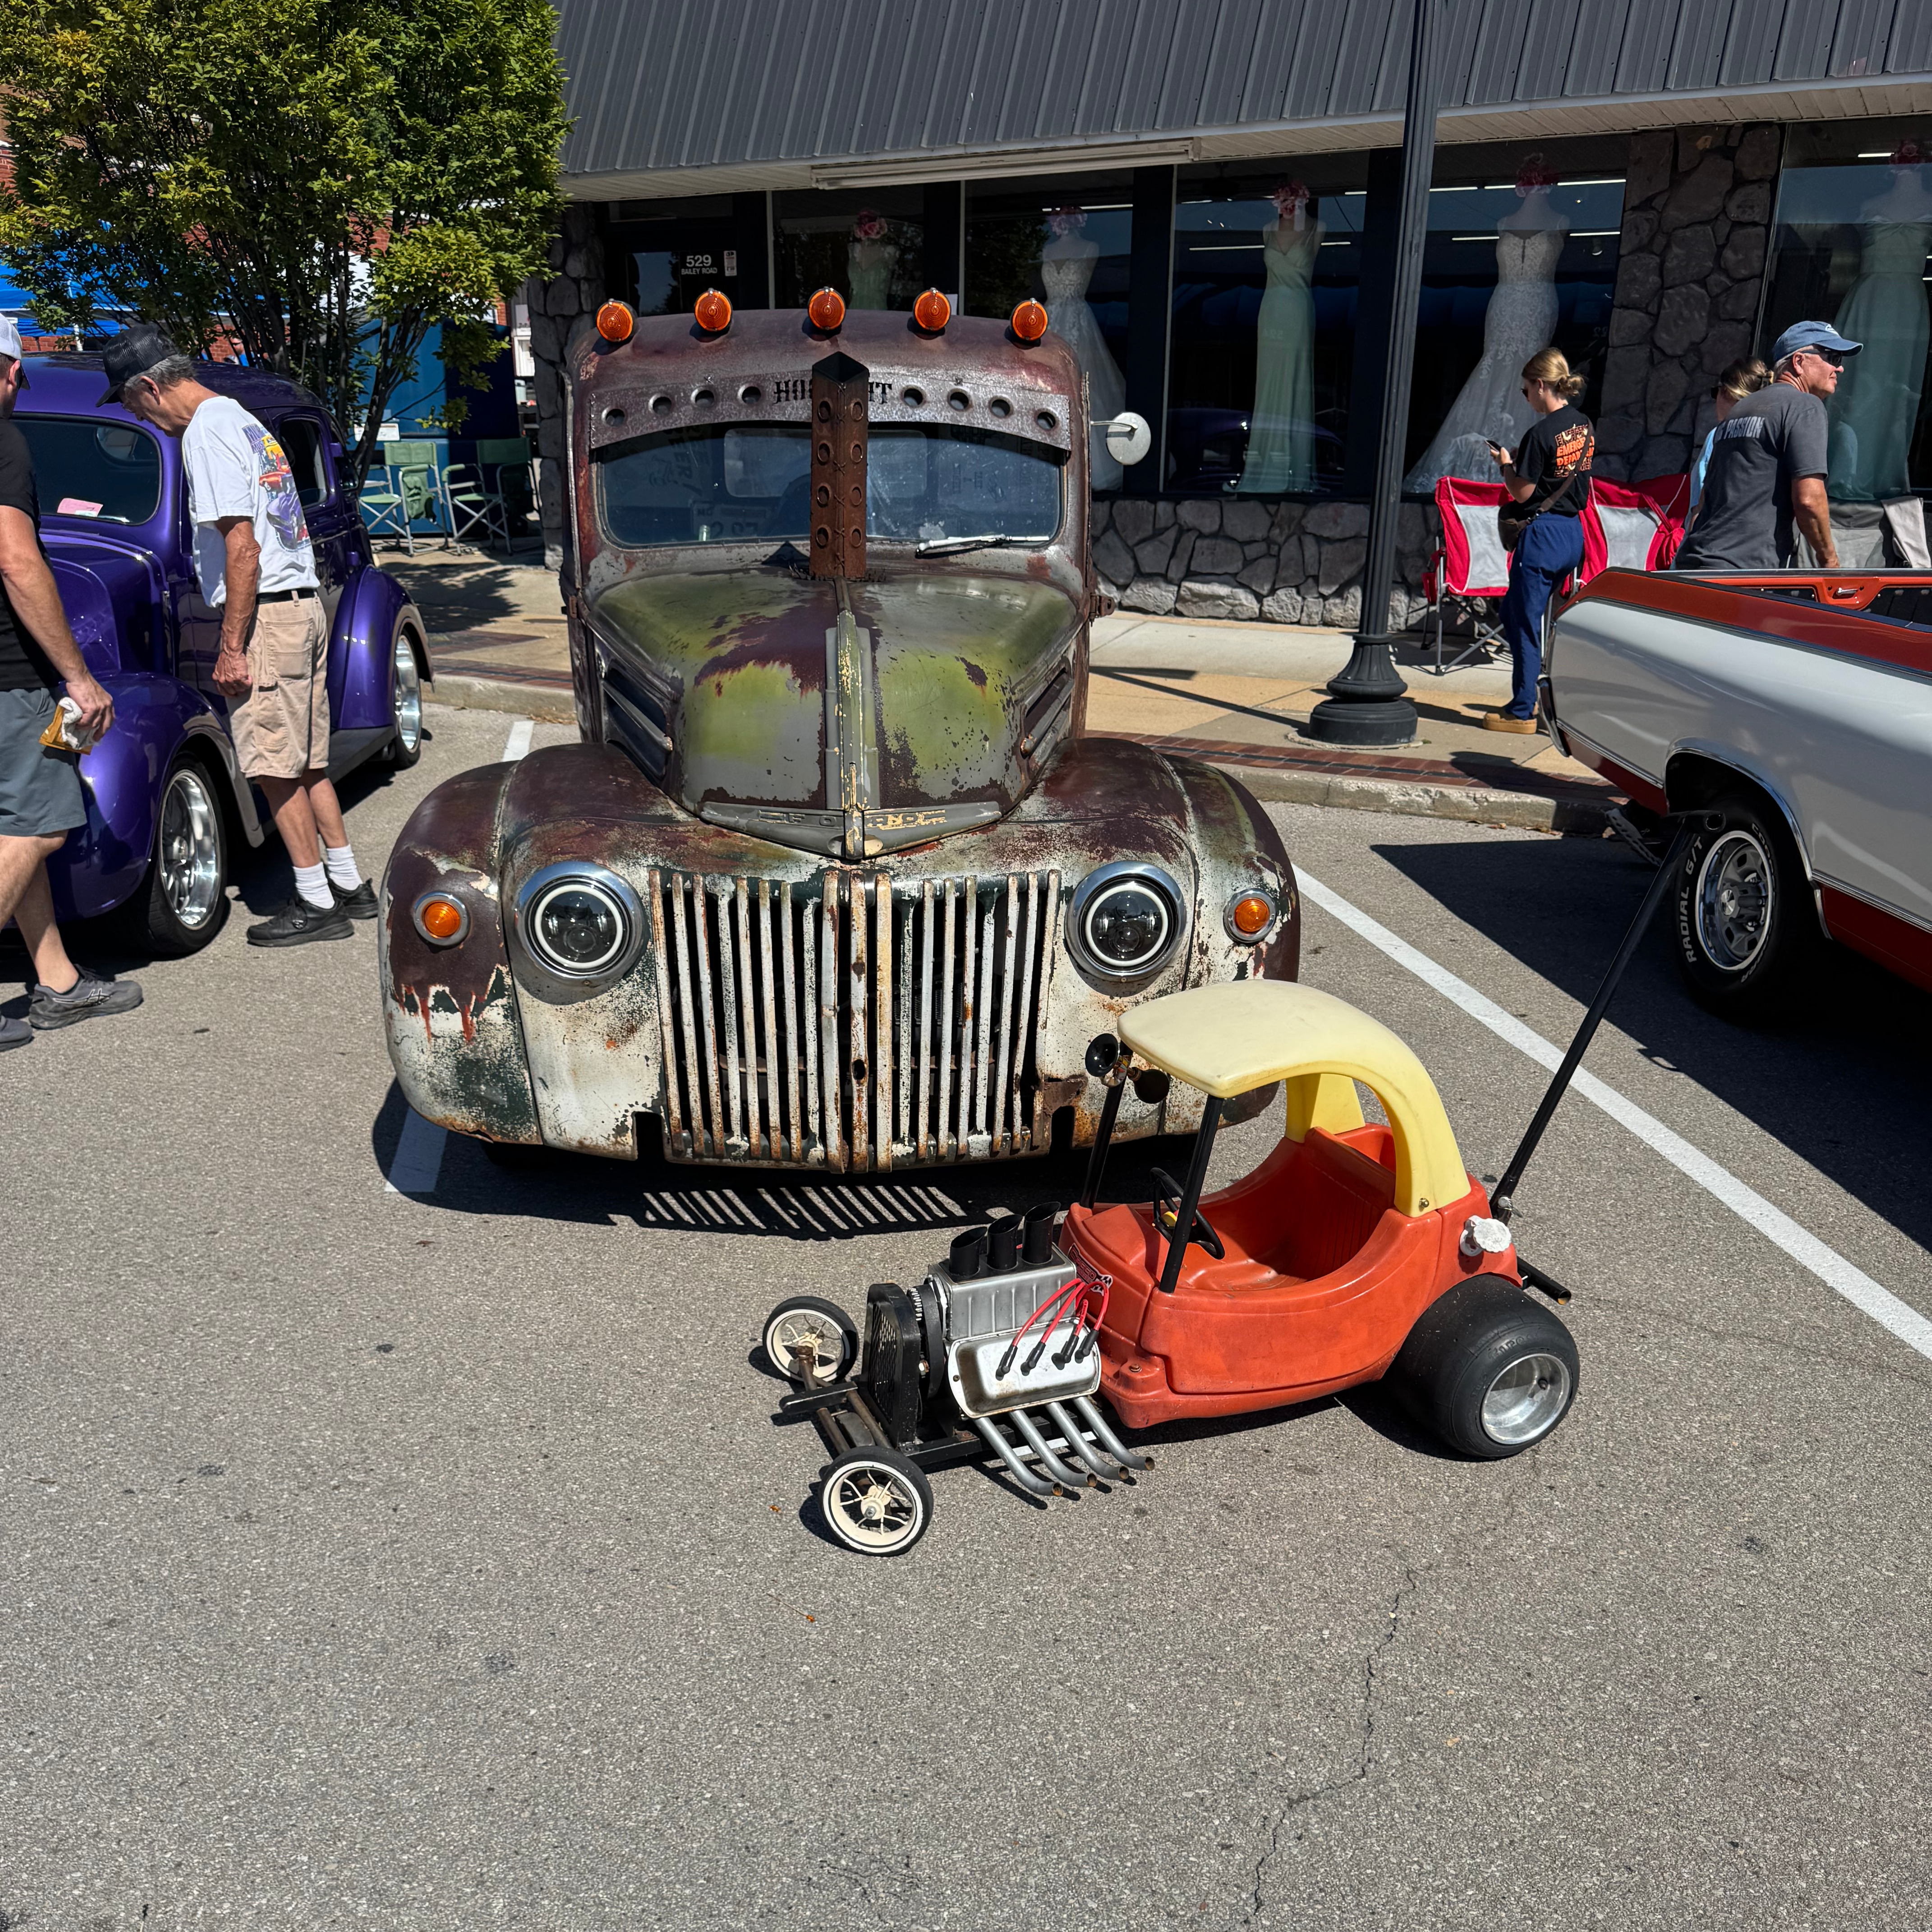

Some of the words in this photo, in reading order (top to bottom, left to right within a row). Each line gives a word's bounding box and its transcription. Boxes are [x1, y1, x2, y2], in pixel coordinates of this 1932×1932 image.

[686, 255, 712, 267] 529
[1724, 416, 1765, 439] PASSION
[1686, 836, 1703, 875] G/T
[1680, 887, 1697, 963] RADIAL
